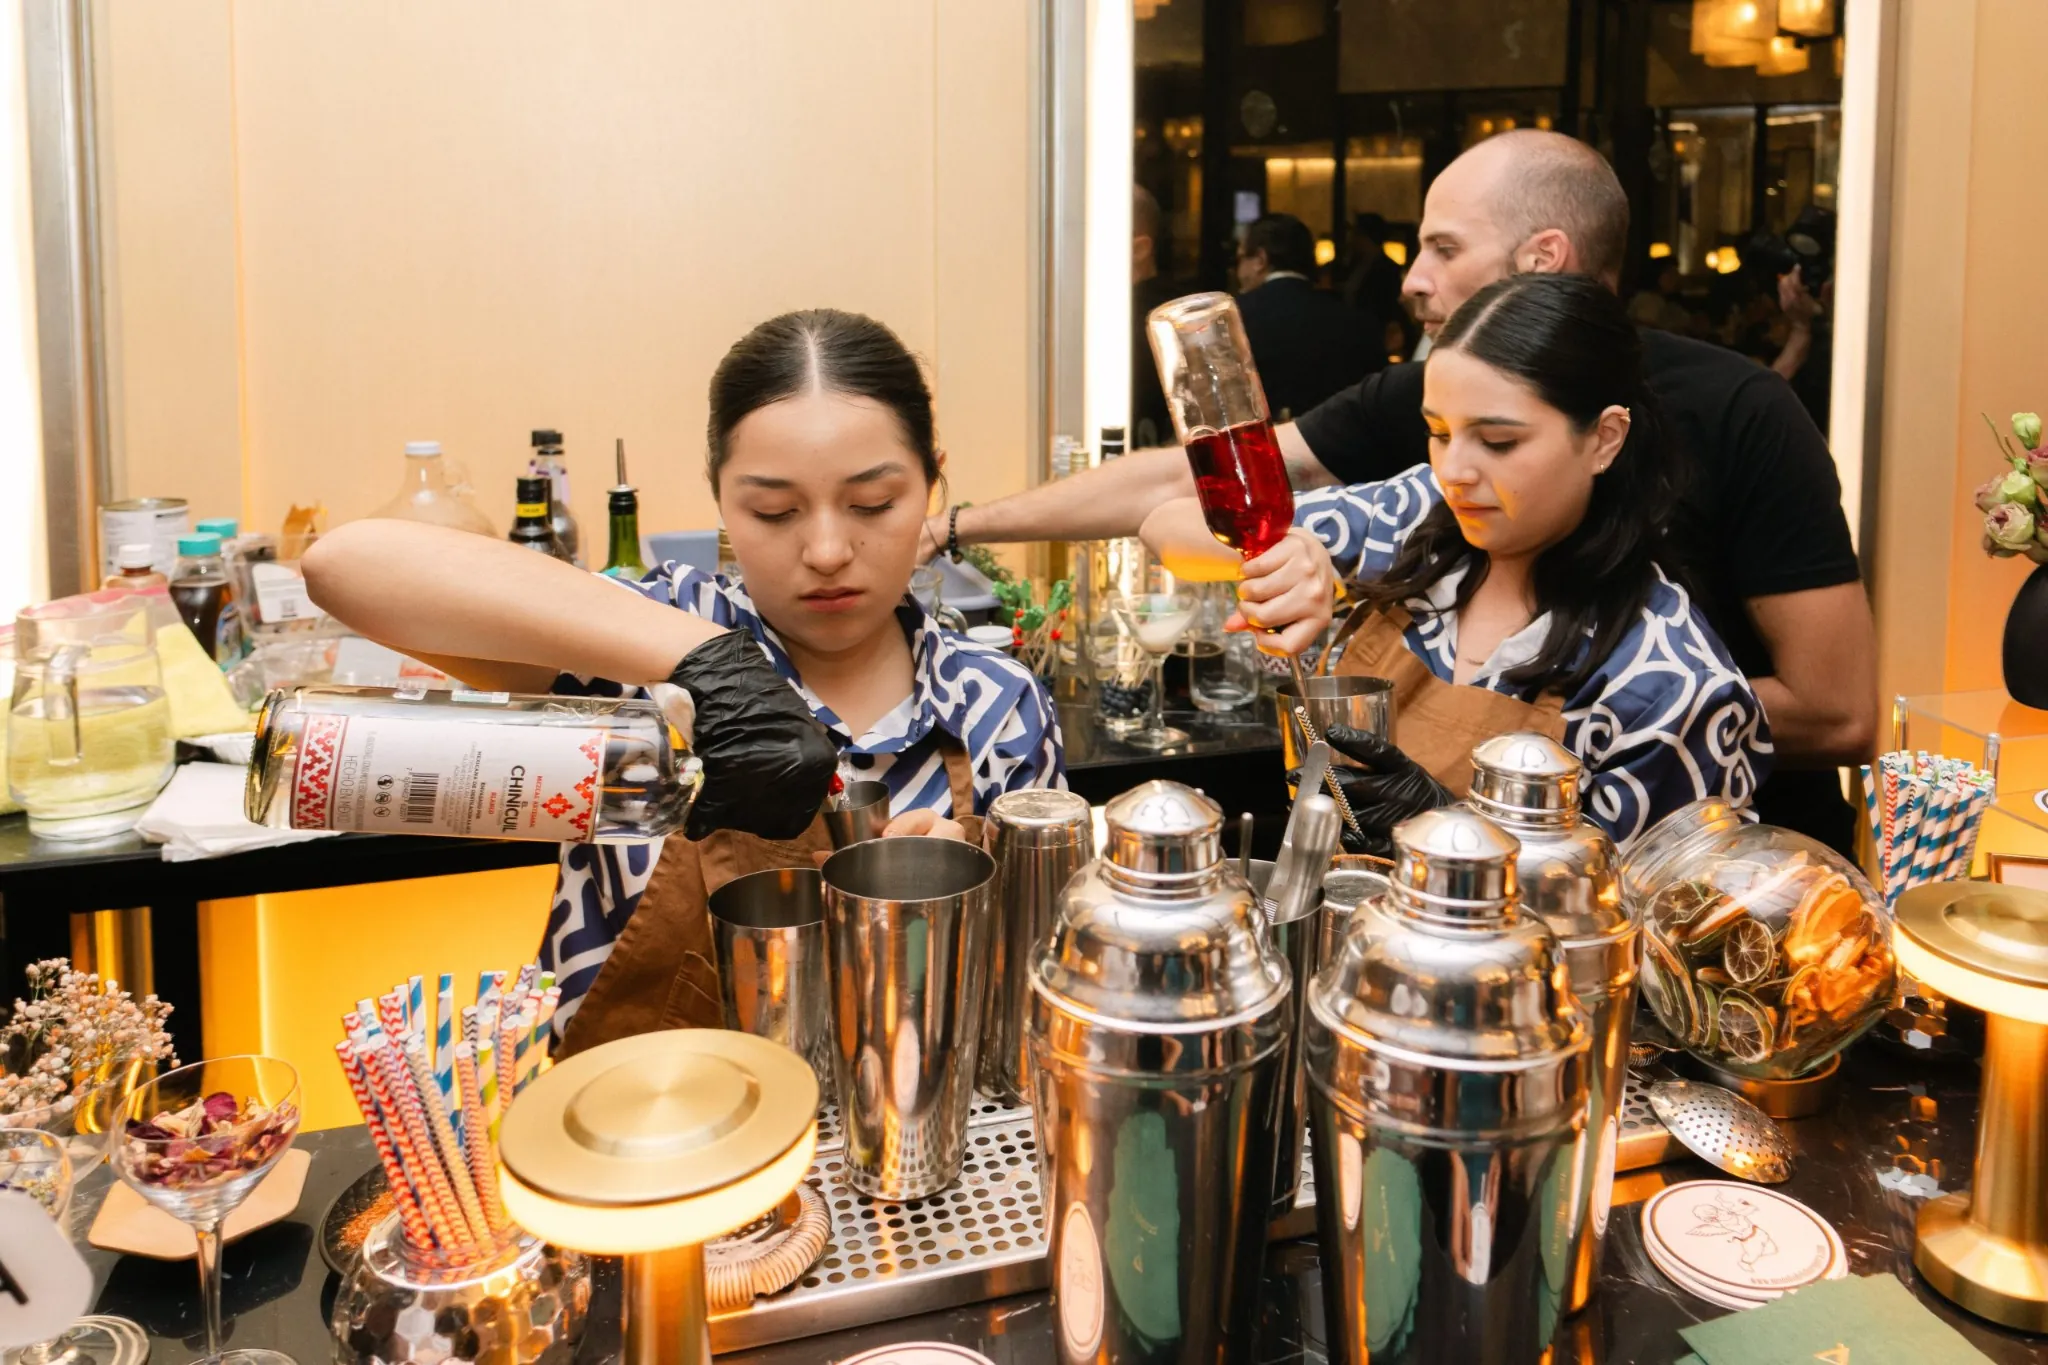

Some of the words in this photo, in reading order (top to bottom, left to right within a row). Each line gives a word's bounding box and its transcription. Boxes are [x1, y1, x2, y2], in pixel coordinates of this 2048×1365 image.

[340, 755, 358, 787] HECHO
[338, 788, 354, 803] EN
[501, 765, 526, 833] CHINICUIL
[534, 775, 543, 800] MEZCAL
[521, 801, 529, 809] EL
